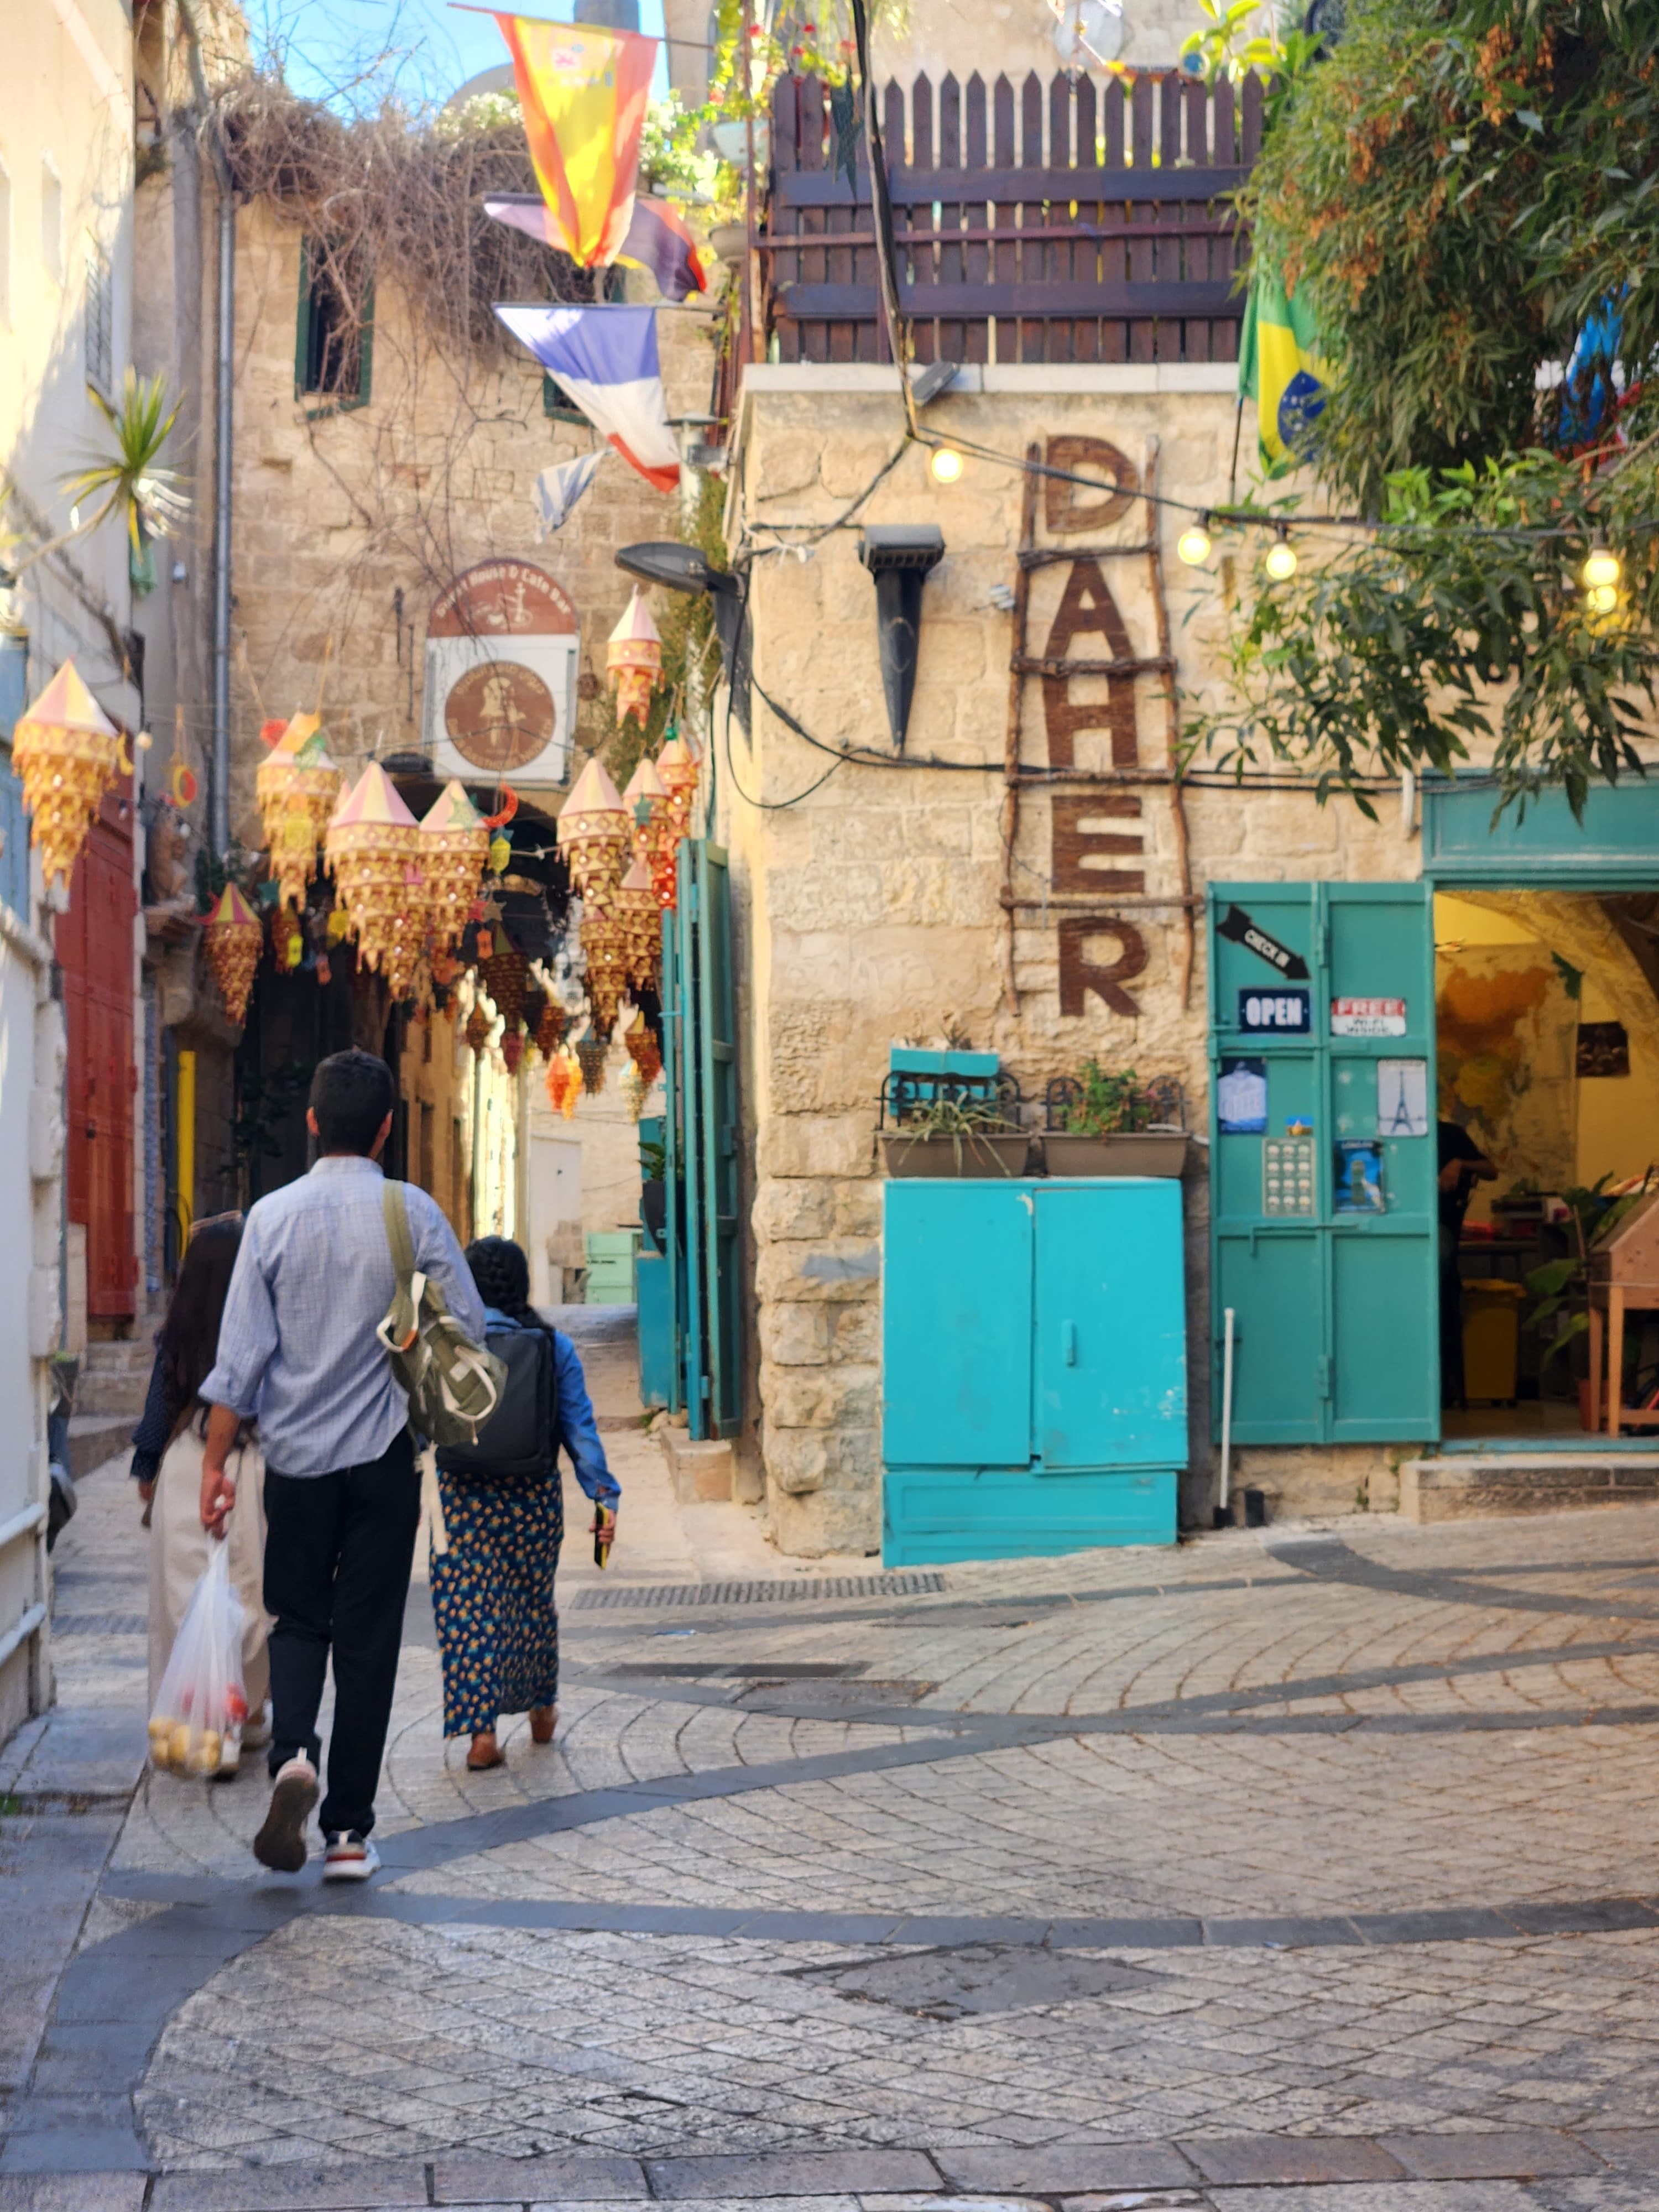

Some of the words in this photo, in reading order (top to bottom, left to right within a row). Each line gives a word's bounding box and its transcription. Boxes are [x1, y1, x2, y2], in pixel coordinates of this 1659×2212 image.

[1042, 434, 1149, 1018] DAHER
[1244, 929, 1280, 961] CHECK
[1245, 997, 1302, 1026] OPEN
[1338, 998, 1399, 1016] FREE
